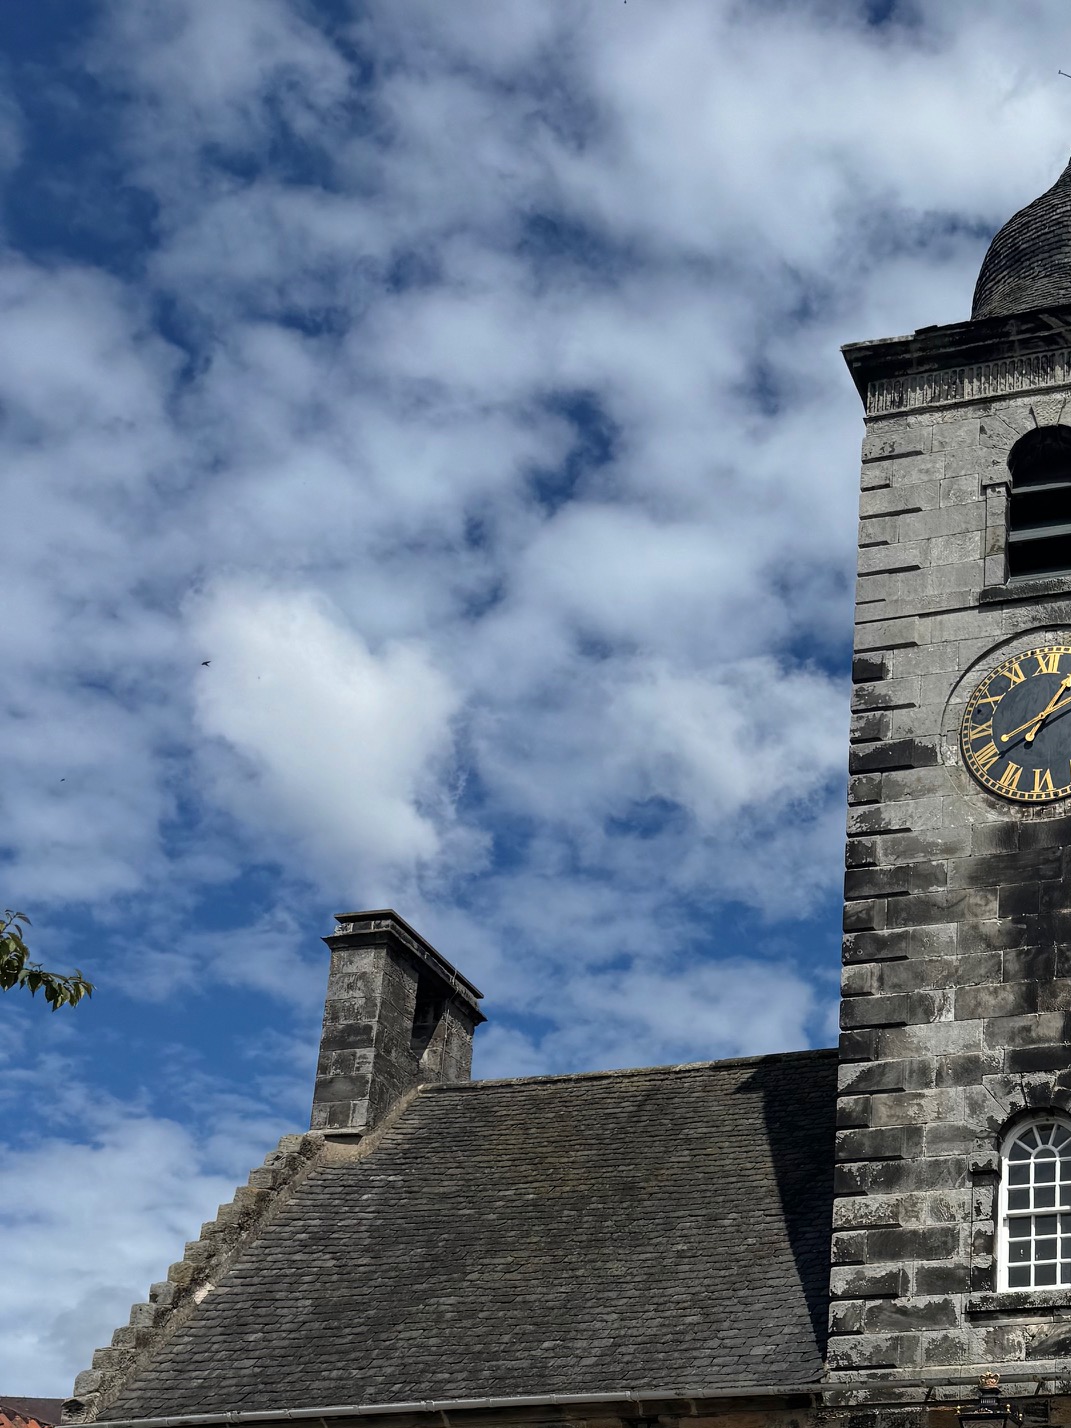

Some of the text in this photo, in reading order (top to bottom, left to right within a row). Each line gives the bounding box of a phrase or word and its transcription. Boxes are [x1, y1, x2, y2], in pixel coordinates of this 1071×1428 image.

[999, 661, 1027, 691] XI
[1032, 653, 1063, 677] XII
[976, 685, 1006, 714] X
[970, 716, 993, 742] IX
[973, 738, 1001, 773] VIII
[997, 760, 1023, 790] VII
[1031, 768, 1056, 792] VI
